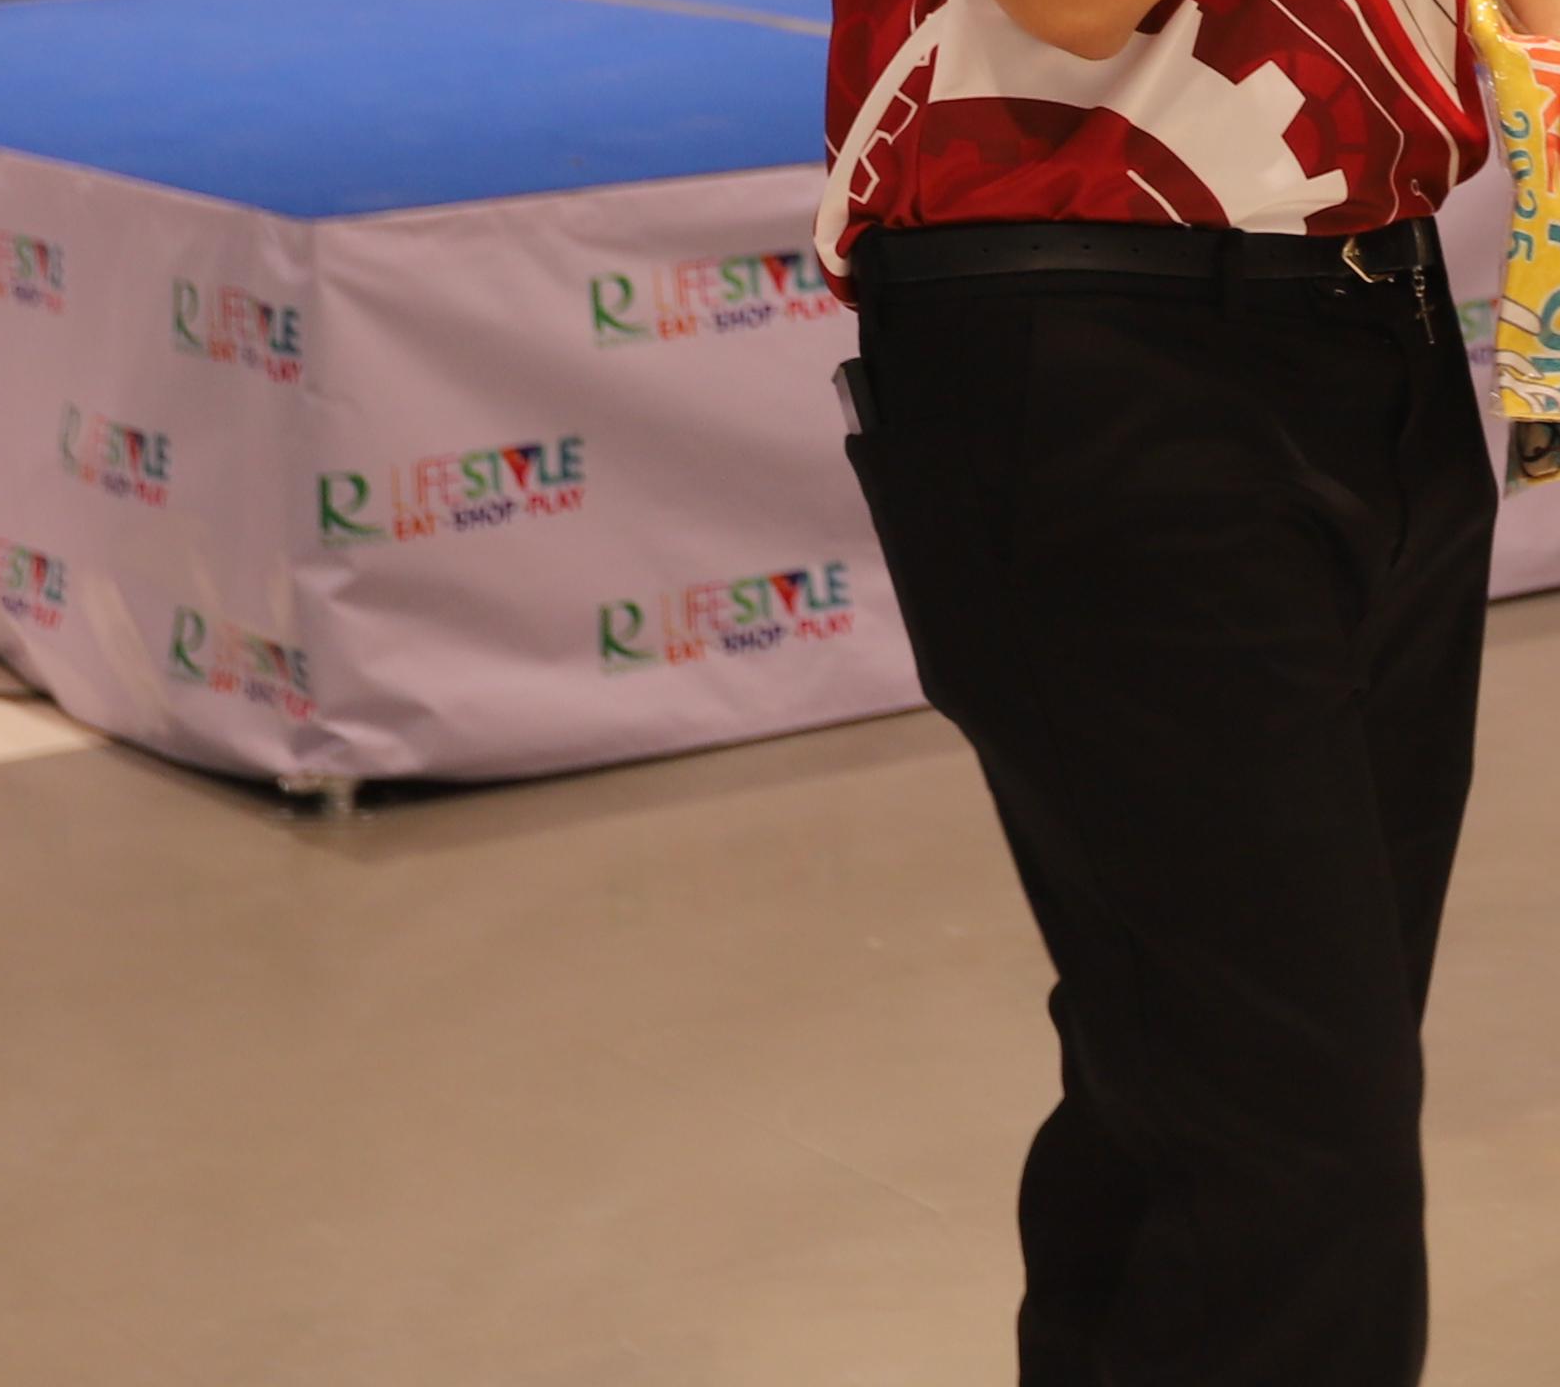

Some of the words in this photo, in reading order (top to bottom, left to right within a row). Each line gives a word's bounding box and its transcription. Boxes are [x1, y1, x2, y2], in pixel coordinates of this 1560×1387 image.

[651, 251, 827, 312] LIFESTYL
[392, 435, 585, 514] LIFESTYLE
[394, 513, 436, 543] EAT
[450, 499, 516, 534] SHOP
[525, 486, 585, 518] PLAY
[660, 560, 852, 641] LIFESTYLE
[665, 641, 707, 668] EAT
[720, 625, 784, 658] SHOP
[795, 611, 854, 642] PLAY
